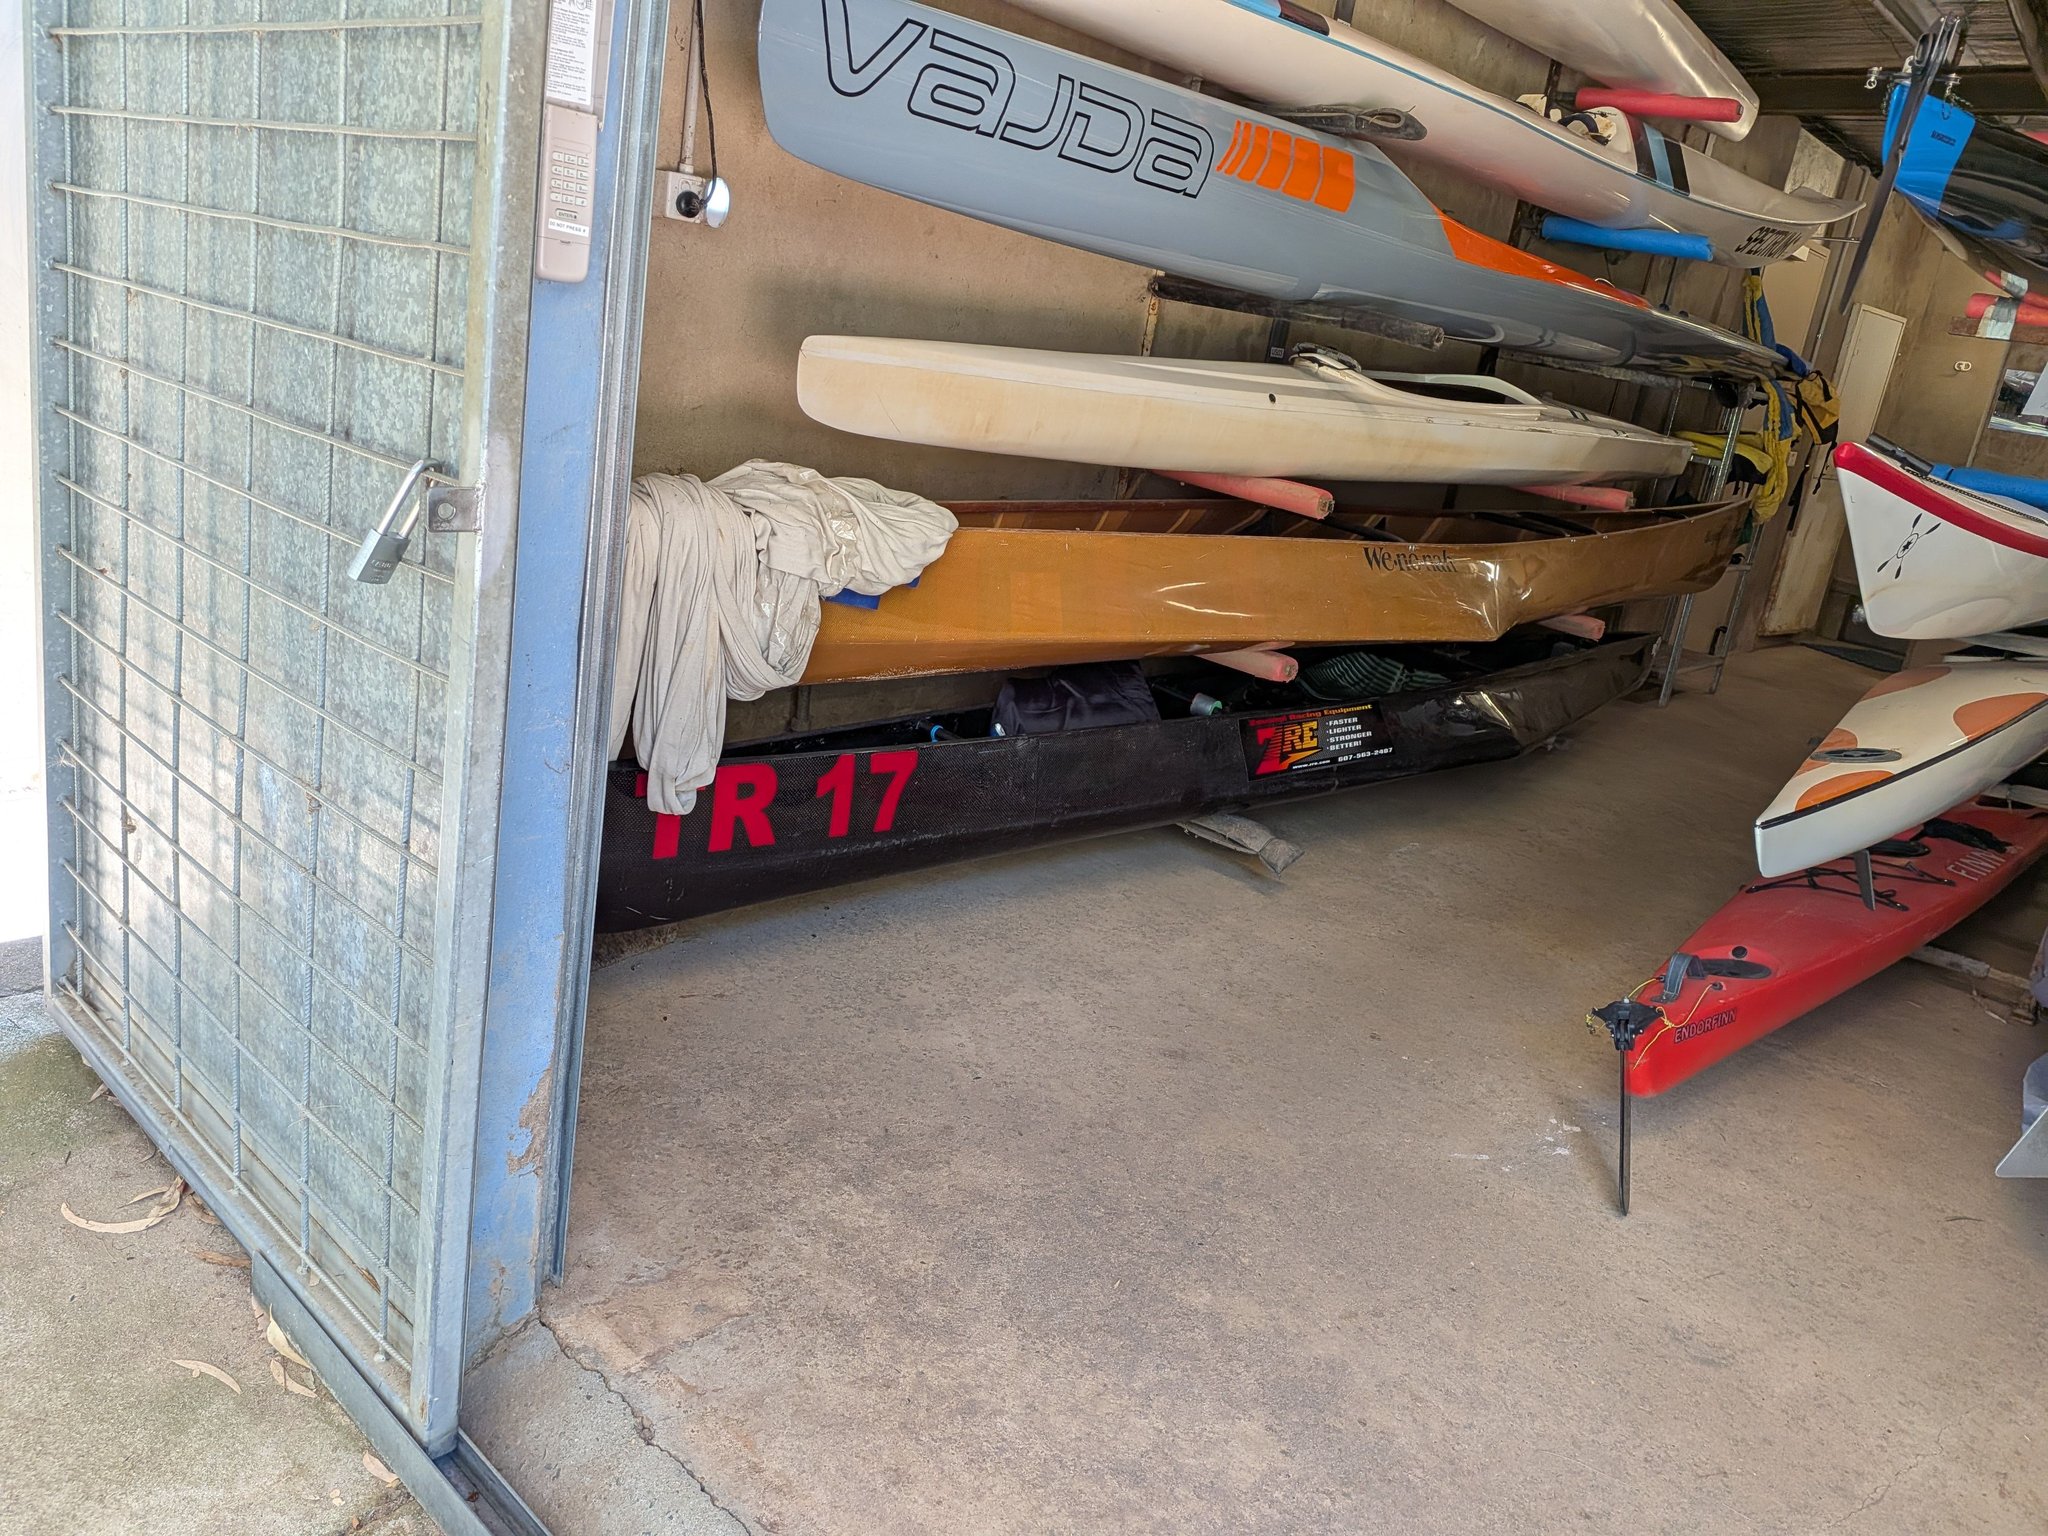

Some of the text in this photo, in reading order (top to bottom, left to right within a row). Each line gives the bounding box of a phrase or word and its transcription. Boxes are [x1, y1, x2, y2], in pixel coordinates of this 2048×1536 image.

[1289, 710, 1322, 720] Racing
[1323, 704, 1373, 715] Equipment
[1329, 717, 1358, 726] FASTER
[1329, 724, 1362, 735] LIGHTER
[1329, 731, 1372, 743] STRONGER
[1329, 740, 1362, 751] BETTER!
[816, 750, 919, 838] 17
[1674, 1007, 1738, 1044] ENDORFINN
